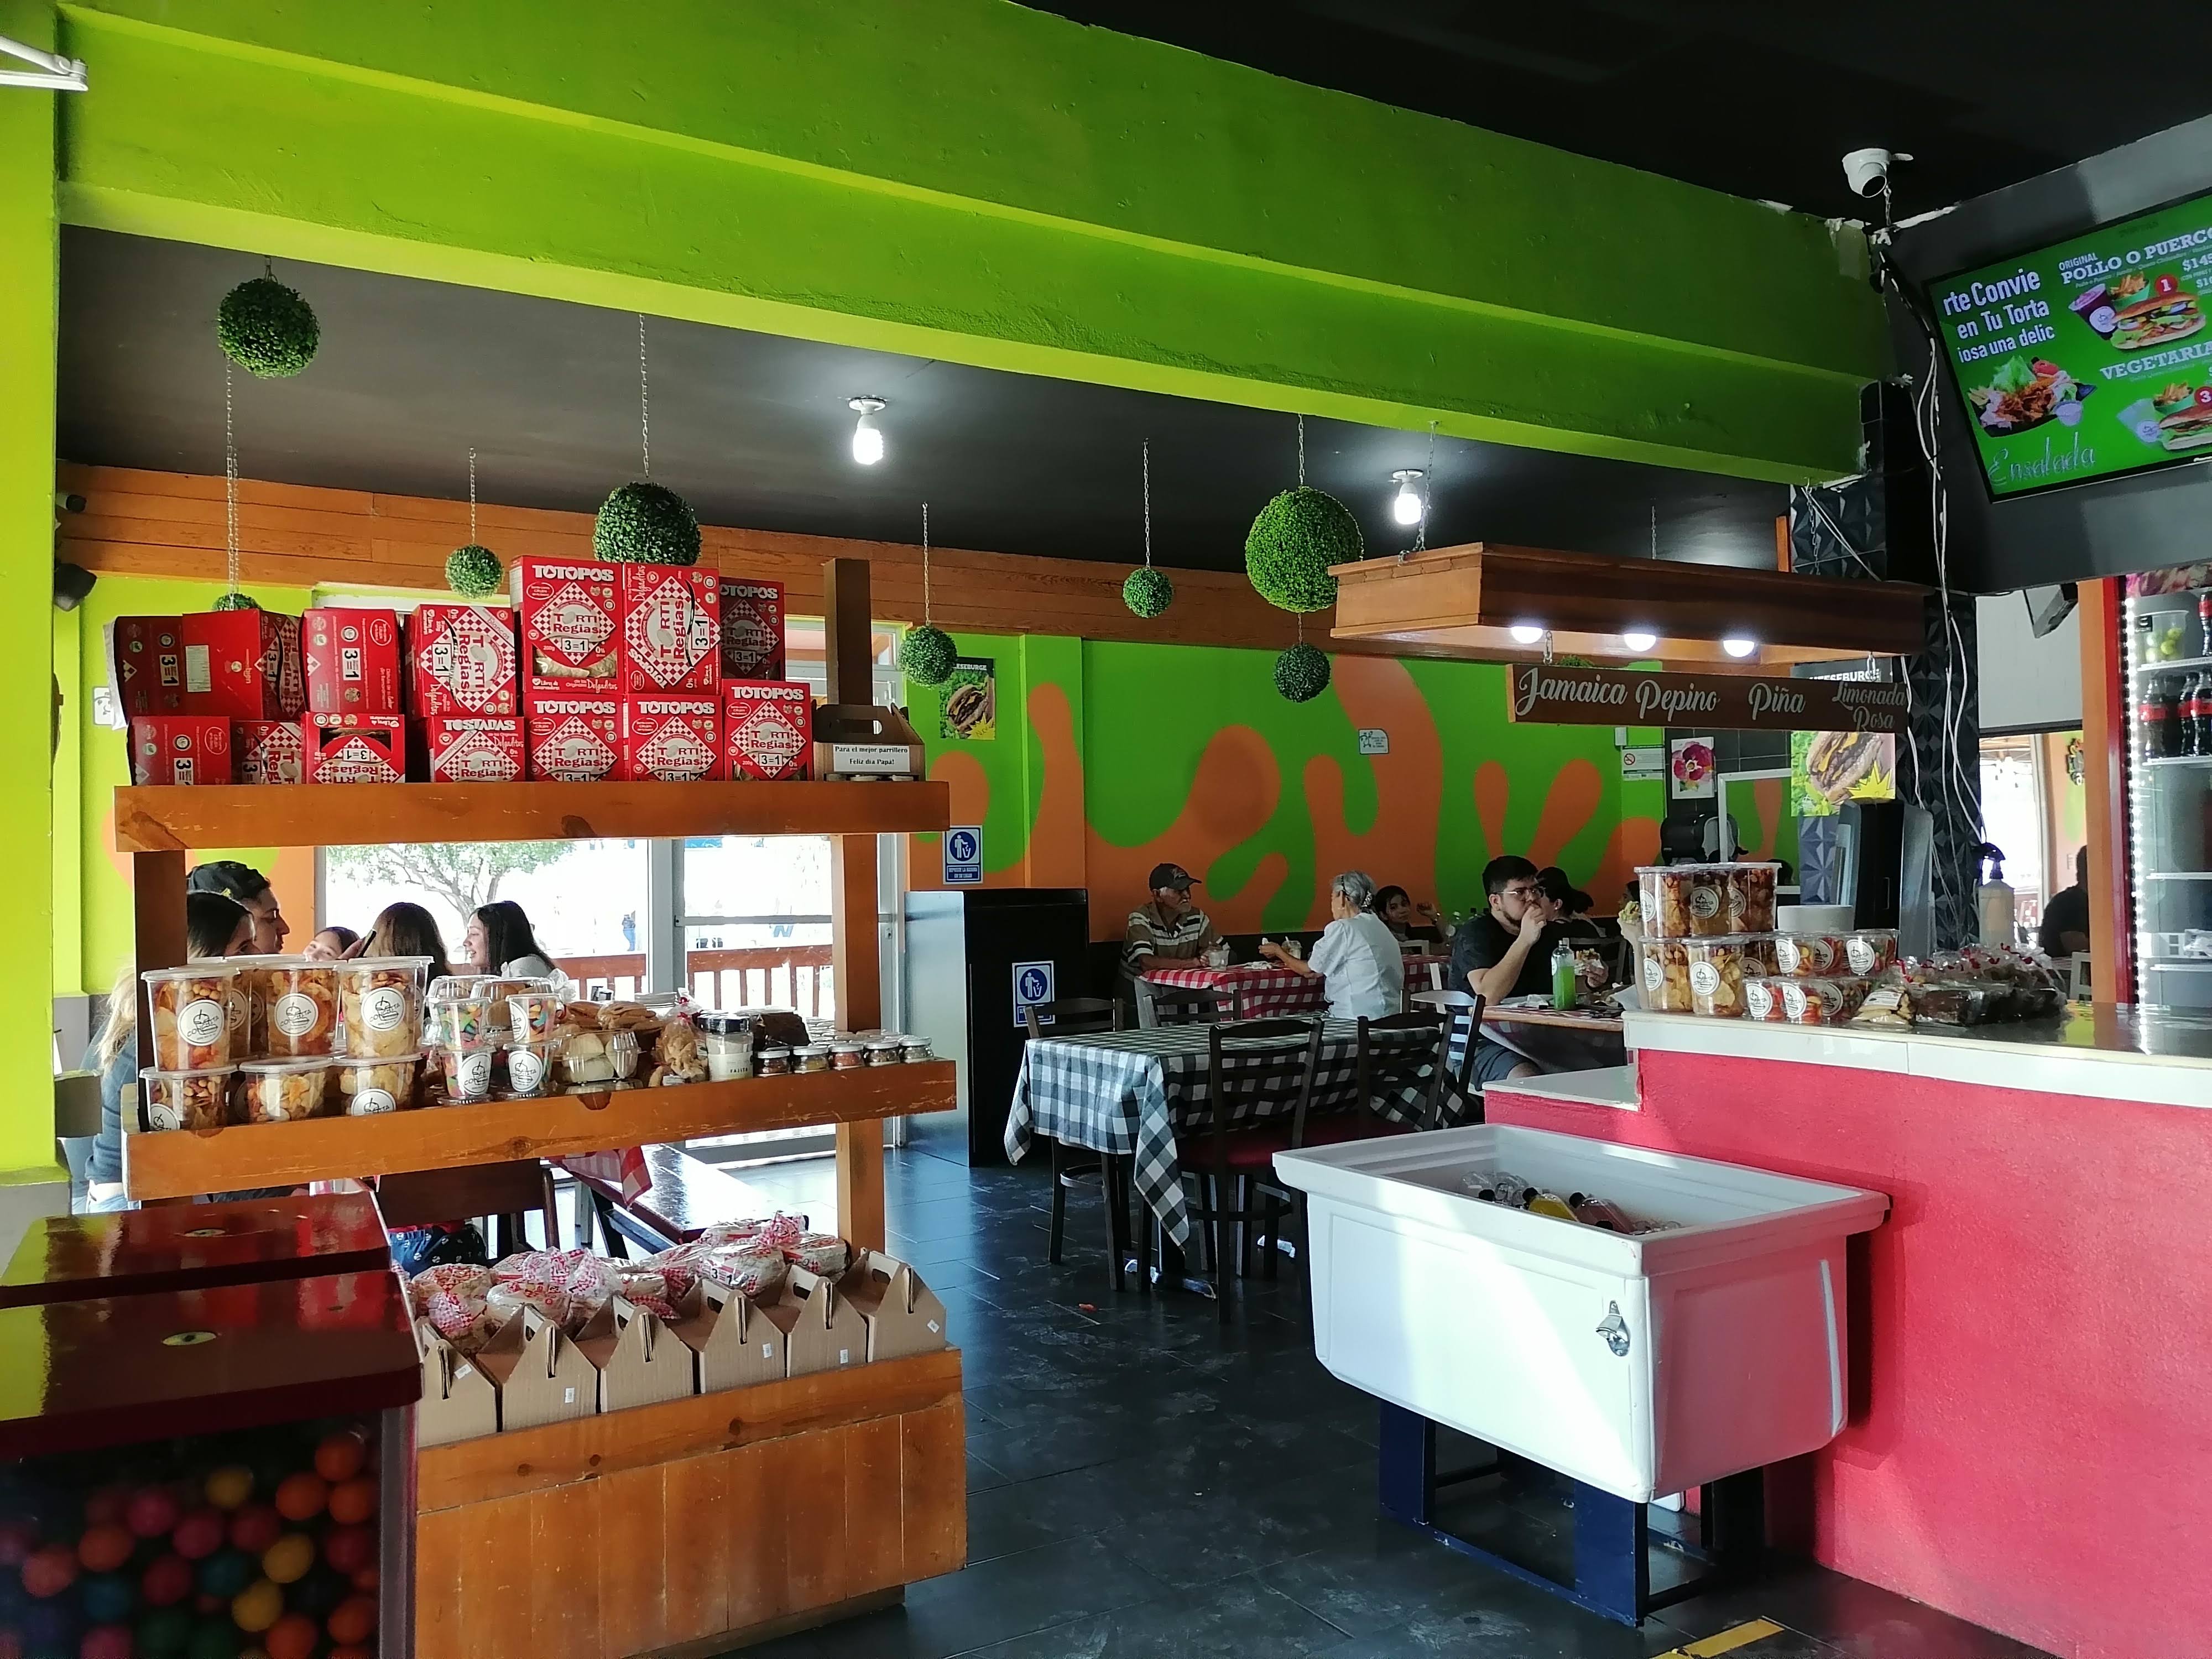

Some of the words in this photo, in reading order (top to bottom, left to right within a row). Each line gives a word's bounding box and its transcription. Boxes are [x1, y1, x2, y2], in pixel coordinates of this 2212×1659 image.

[2059, 252, 2098, 271] ORIGINAL
[2060, 257, 2122, 284] POLLO
[2126, 251, 2141, 264] O
[1943, 291, 1971, 316] rte
[1971, 268, 2041, 306] Convie
[2161, 279, 2171, 292] 1
[1957, 321, 1979, 339] en
[1980, 311, 2003, 332] Tu
[2003, 299, 2049, 325] Torta
[1957, 347, 1988, 363] iosa
[1989, 337, 2017, 354] una
[2018, 324, 2055, 347] delic
[2199, 390, 2212, 403] 3
[1988, 431, 2096, 486] Ensalada
[532, 565, 614, 581] TOTOPOS
[719, 584, 778, 599] OTOPOS
[487, 618, 510, 640] blancas
[553, 624, 599, 637] Regias
[673, 600, 686, 659] Regias
[695, 619, 708, 646] 3=1
[564, 640, 586, 651] 3=1
[727, 637, 766, 647] Regias
[434, 647, 449, 672] 3=1
[458, 634, 471, 690] Regias
[736, 652, 754, 662] 3=1
[628, 648, 667, 689] TOTOPOS
[731, 686, 804, 701] TOTOPOS
[1516, 667, 1628, 716] Jamaica
[1635, 679, 1720, 722] Pepino
[1748, 682, 1806, 721] Piña
[1832, 681, 1906, 711] Limonada
[534, 700, 616, 714] TOTOPOS
[637, 701, 715, 715] TOTOPOS
[443, 718, 516, 731] TOSTADAS
[1854, 706, 1893, 732] Rosa
[751, 740, 792, 750] Regias
[347, 750, 368, 760] 3=1
[657, 757, 701, 766] Regias
[761, 755, 780, 765] 3=1
[332, 765, 379, 774] Regias
[555, 758, 601, 768] Regias
[461, 769, 505, 778] Regias
